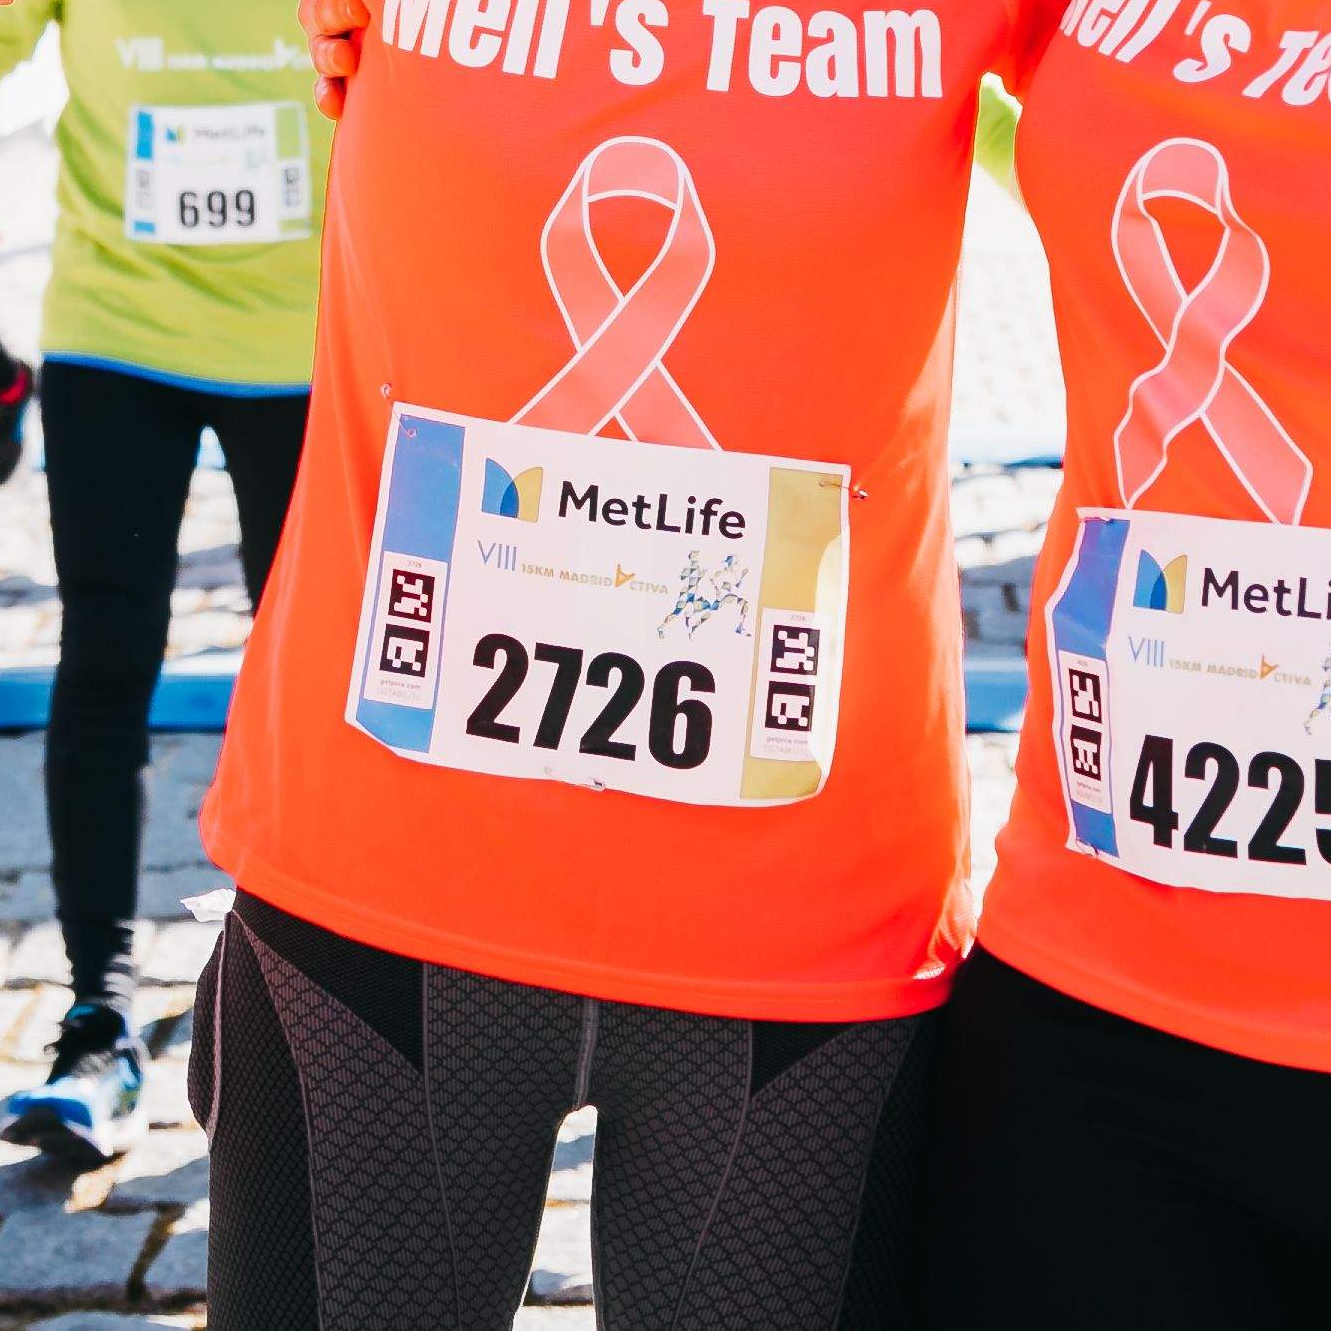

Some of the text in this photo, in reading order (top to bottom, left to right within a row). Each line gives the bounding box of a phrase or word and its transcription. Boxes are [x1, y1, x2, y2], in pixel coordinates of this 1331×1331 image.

[178, 189, 256, 229] 699
[558, 480, 746, 540] MetLife
[477, 539, 518, 571] VIII
[521, 563, 555, 578] 15KM
[559, 570, 613, 587] MADRID
[1128, 636, 1165, 668] VIII
[1170, 659, 1202, 672] 15KM
[1207, 664, 1258, 679] MADRID
[466, 633, 716, 770] 2726
